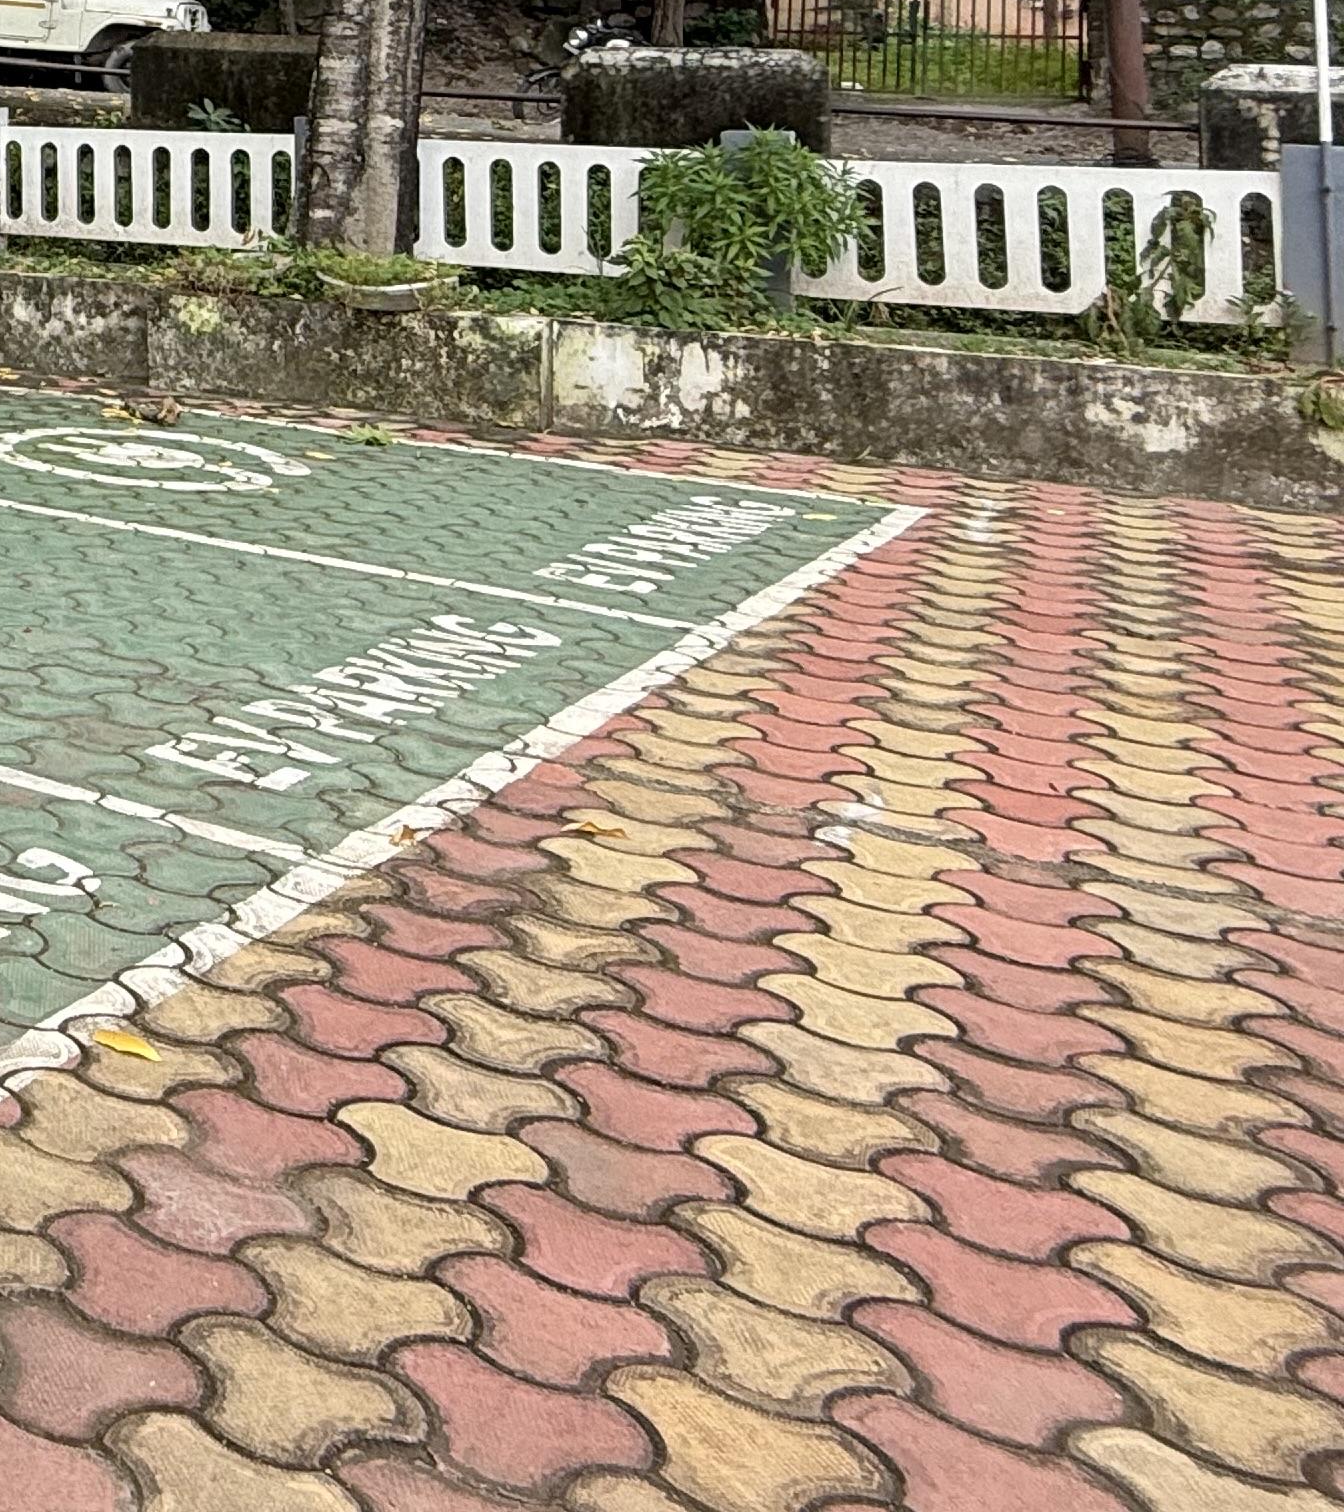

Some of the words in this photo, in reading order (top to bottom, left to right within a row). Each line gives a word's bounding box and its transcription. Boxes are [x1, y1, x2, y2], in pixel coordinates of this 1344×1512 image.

[583, 495, 797, 568] PARKING
[242, 613, 562, 744] PARKING
[144, 716, 343, 791] EV
